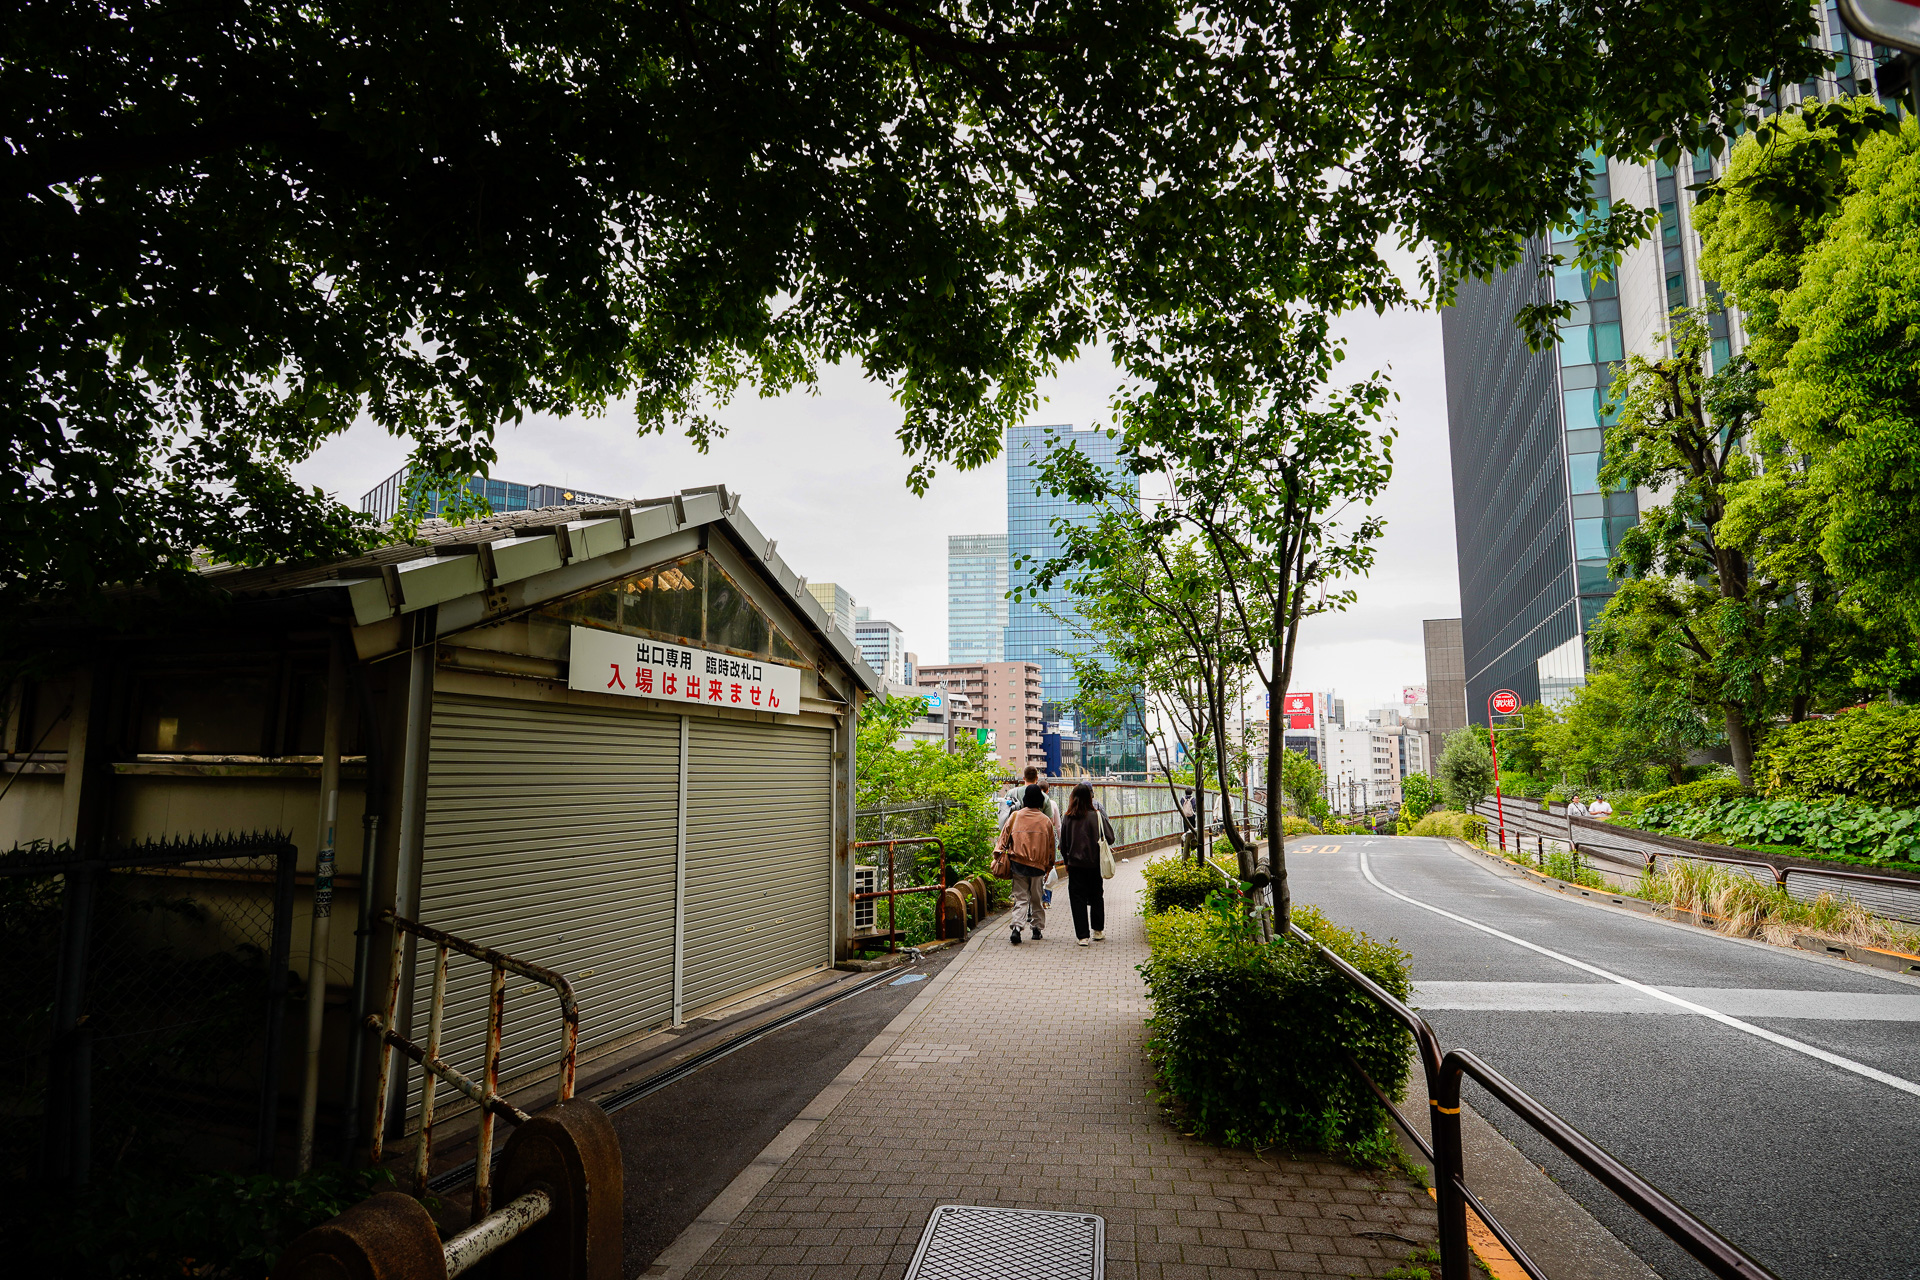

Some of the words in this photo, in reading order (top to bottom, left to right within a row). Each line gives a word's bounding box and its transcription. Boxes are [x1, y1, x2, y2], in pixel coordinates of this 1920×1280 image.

[636, 643, 692, 670] 出口専用
[705, 656, 762, 682] 臨時改札口
[607, 663, 780, 708] 入場は出来ません
[1495, 698, 1515, 708] 消火栓
[1292, 845, 1342, 854] 30
